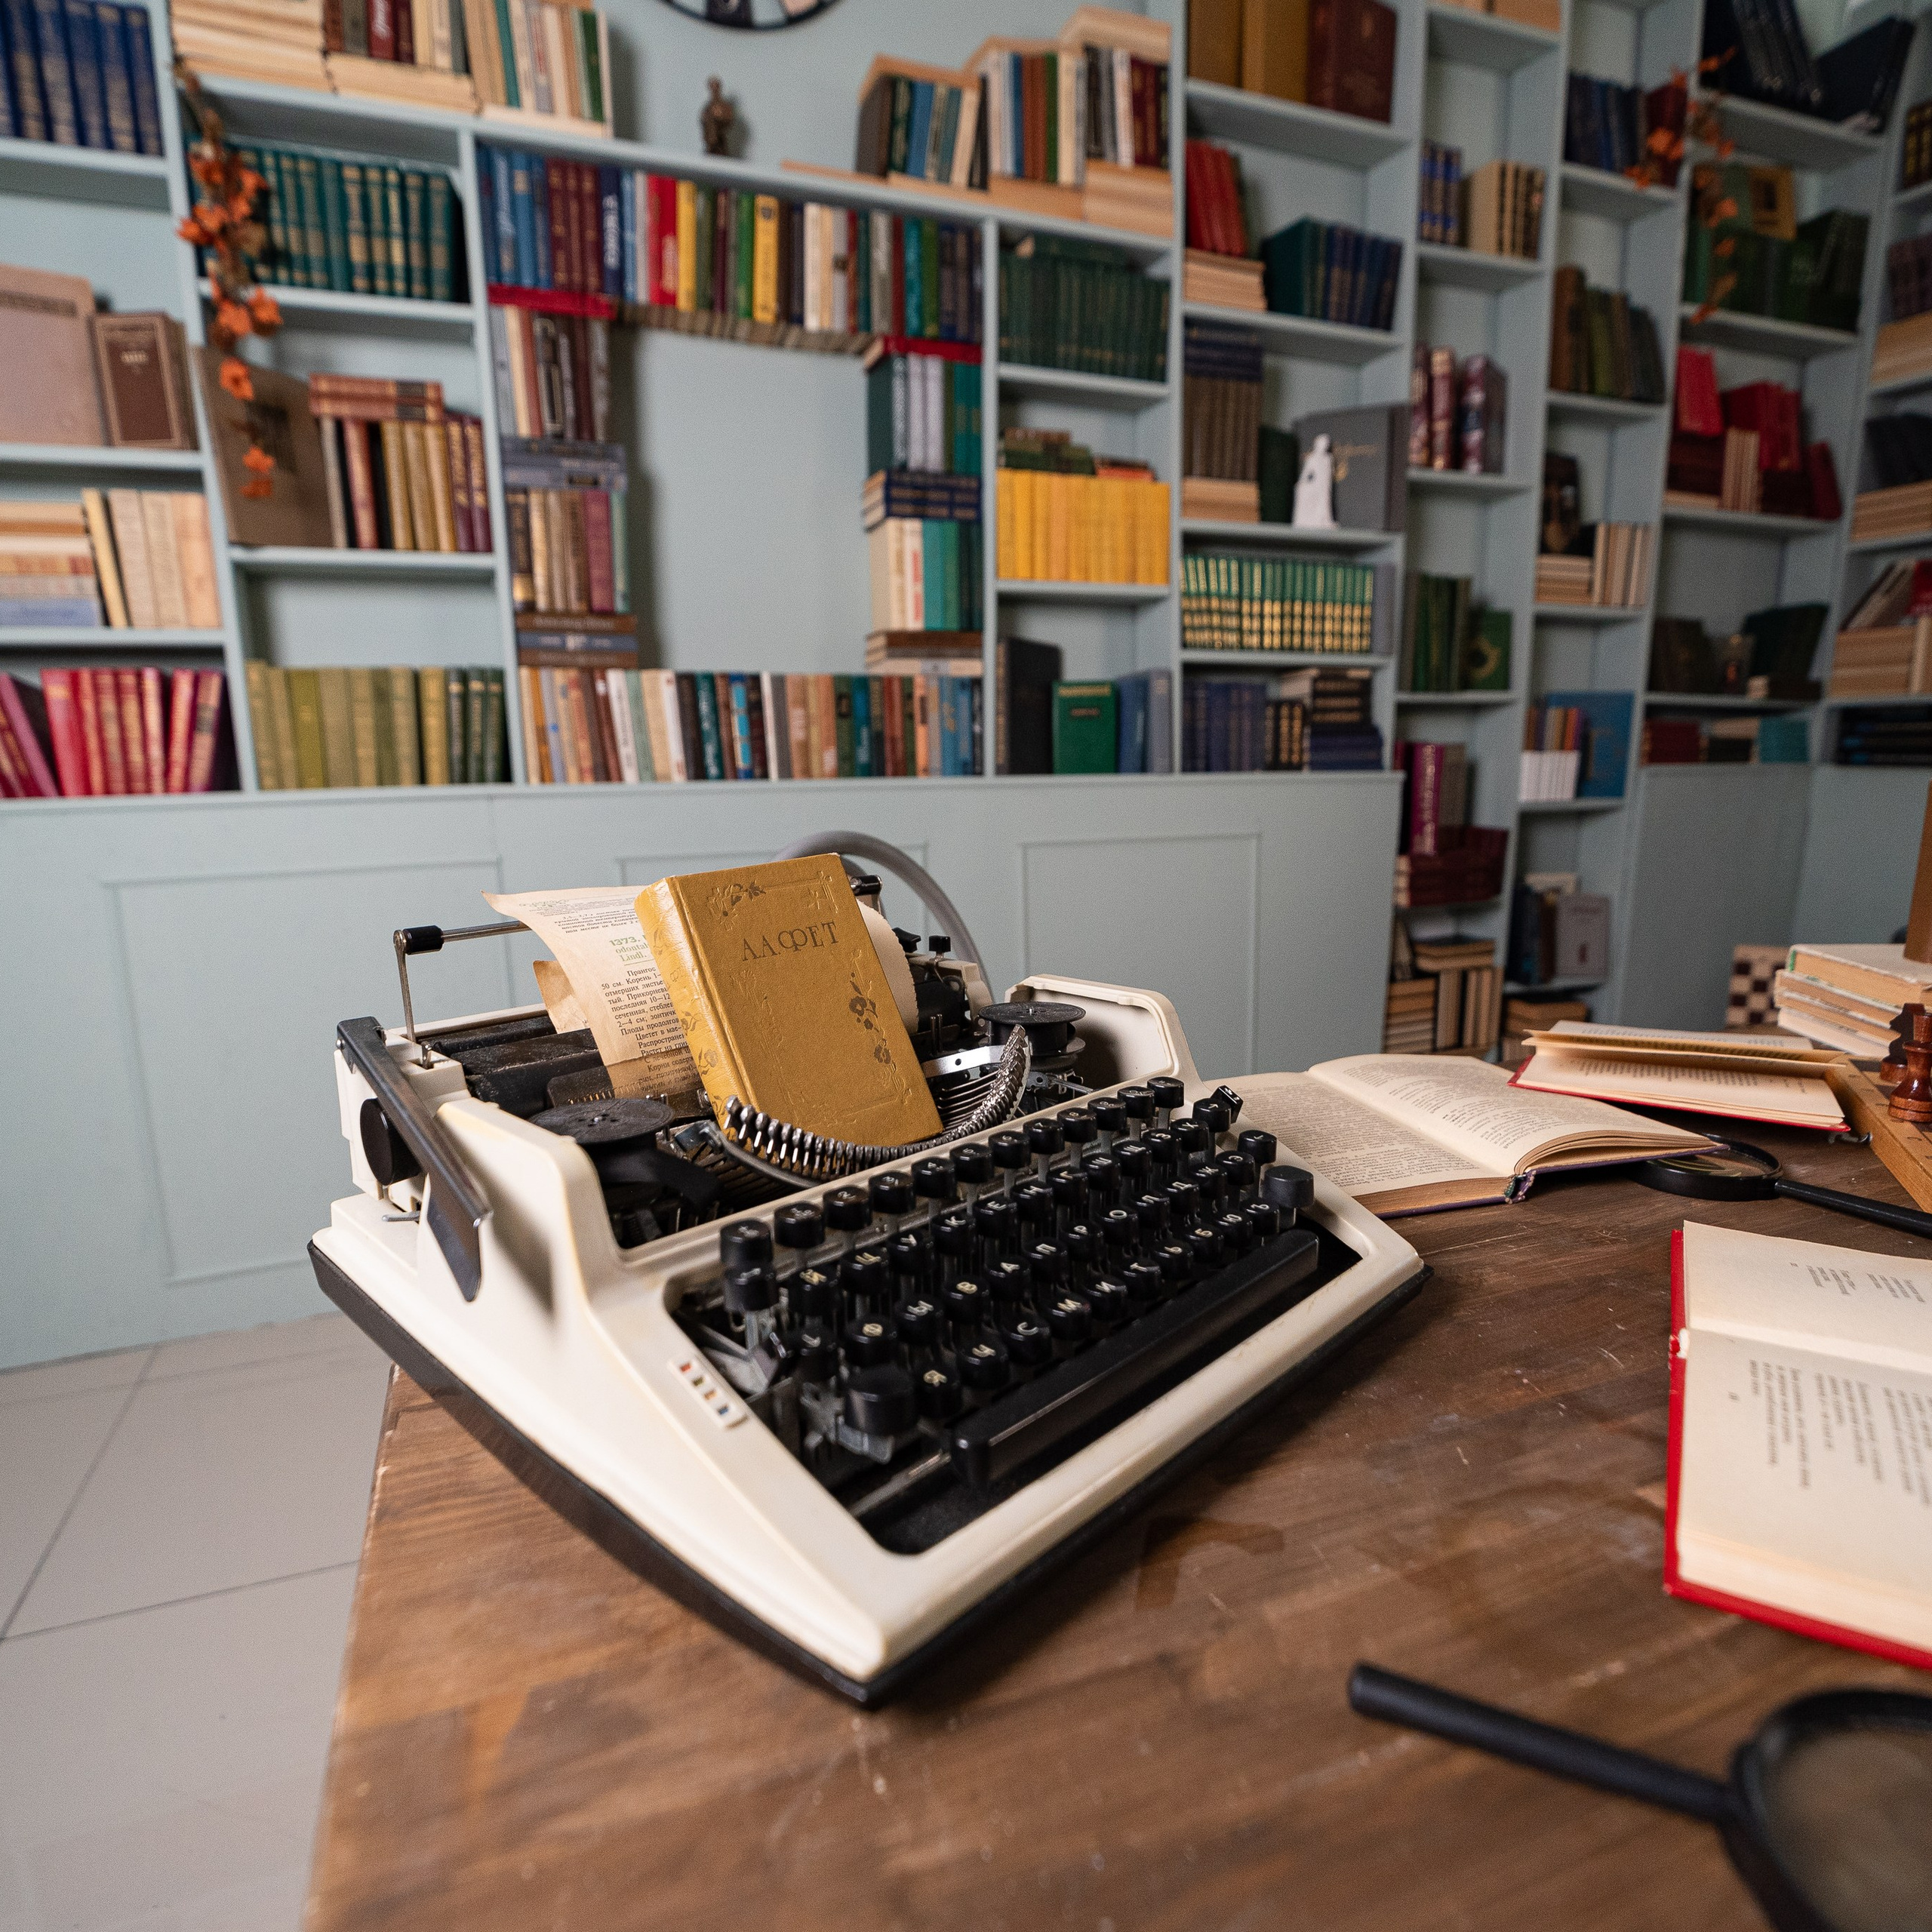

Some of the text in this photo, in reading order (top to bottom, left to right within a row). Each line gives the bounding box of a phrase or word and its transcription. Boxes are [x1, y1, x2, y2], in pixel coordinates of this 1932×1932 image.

[609, 936, 641, 946] 1373.
[615, 943, 649, 955] odontal
[619, 951, 647, 962] Lindl.
[625, 974, 652, 985] Корень
[605, 986, 640, 998] отмерших
[611, 1000, 648, 1013] последняя
[620, 1026, 645, 1036] Плоды
[635, 1030, 659, 1041] Цветет
[640, 1047, 663, 1057] Растет
[647, 1062, 670, 1072] Корни
[901, 1234, 917, 1246] У
[945, 1216, 966, 1226] К
[987, 1201, 1007, 1210] Е
[1023, 1185, 1044, 1195] Н
[1060, 1171, 1073, 1180] Г
[1091, 1157, 1112, 1165] Ш
[863, 1323, 883, 1336] Ф
[956, 1281, 977, 1294] В
[1001, 1262, 1019, 1272] А
[1035, 1243, 1057, 1255] П
[1073, 1225, 1088, 1235] Р
[1109, 1210, 1128, 1218] О
[1141, 1195, 1161, 1204] Л
[1172, 1181, 1192, 1190] Д
[1204, 1166, 1219, 1175] Ж
[924, 1370, 946, 1386] Я
[1017, 1321, 1039, 1336] С
[1057, 1299, 1081, 1312] М
[1096, 1281, 1116, 1293] И
[1130, 1262, 1148, 1272] Т
[1223, 1214, 1242, 1223] Ю
